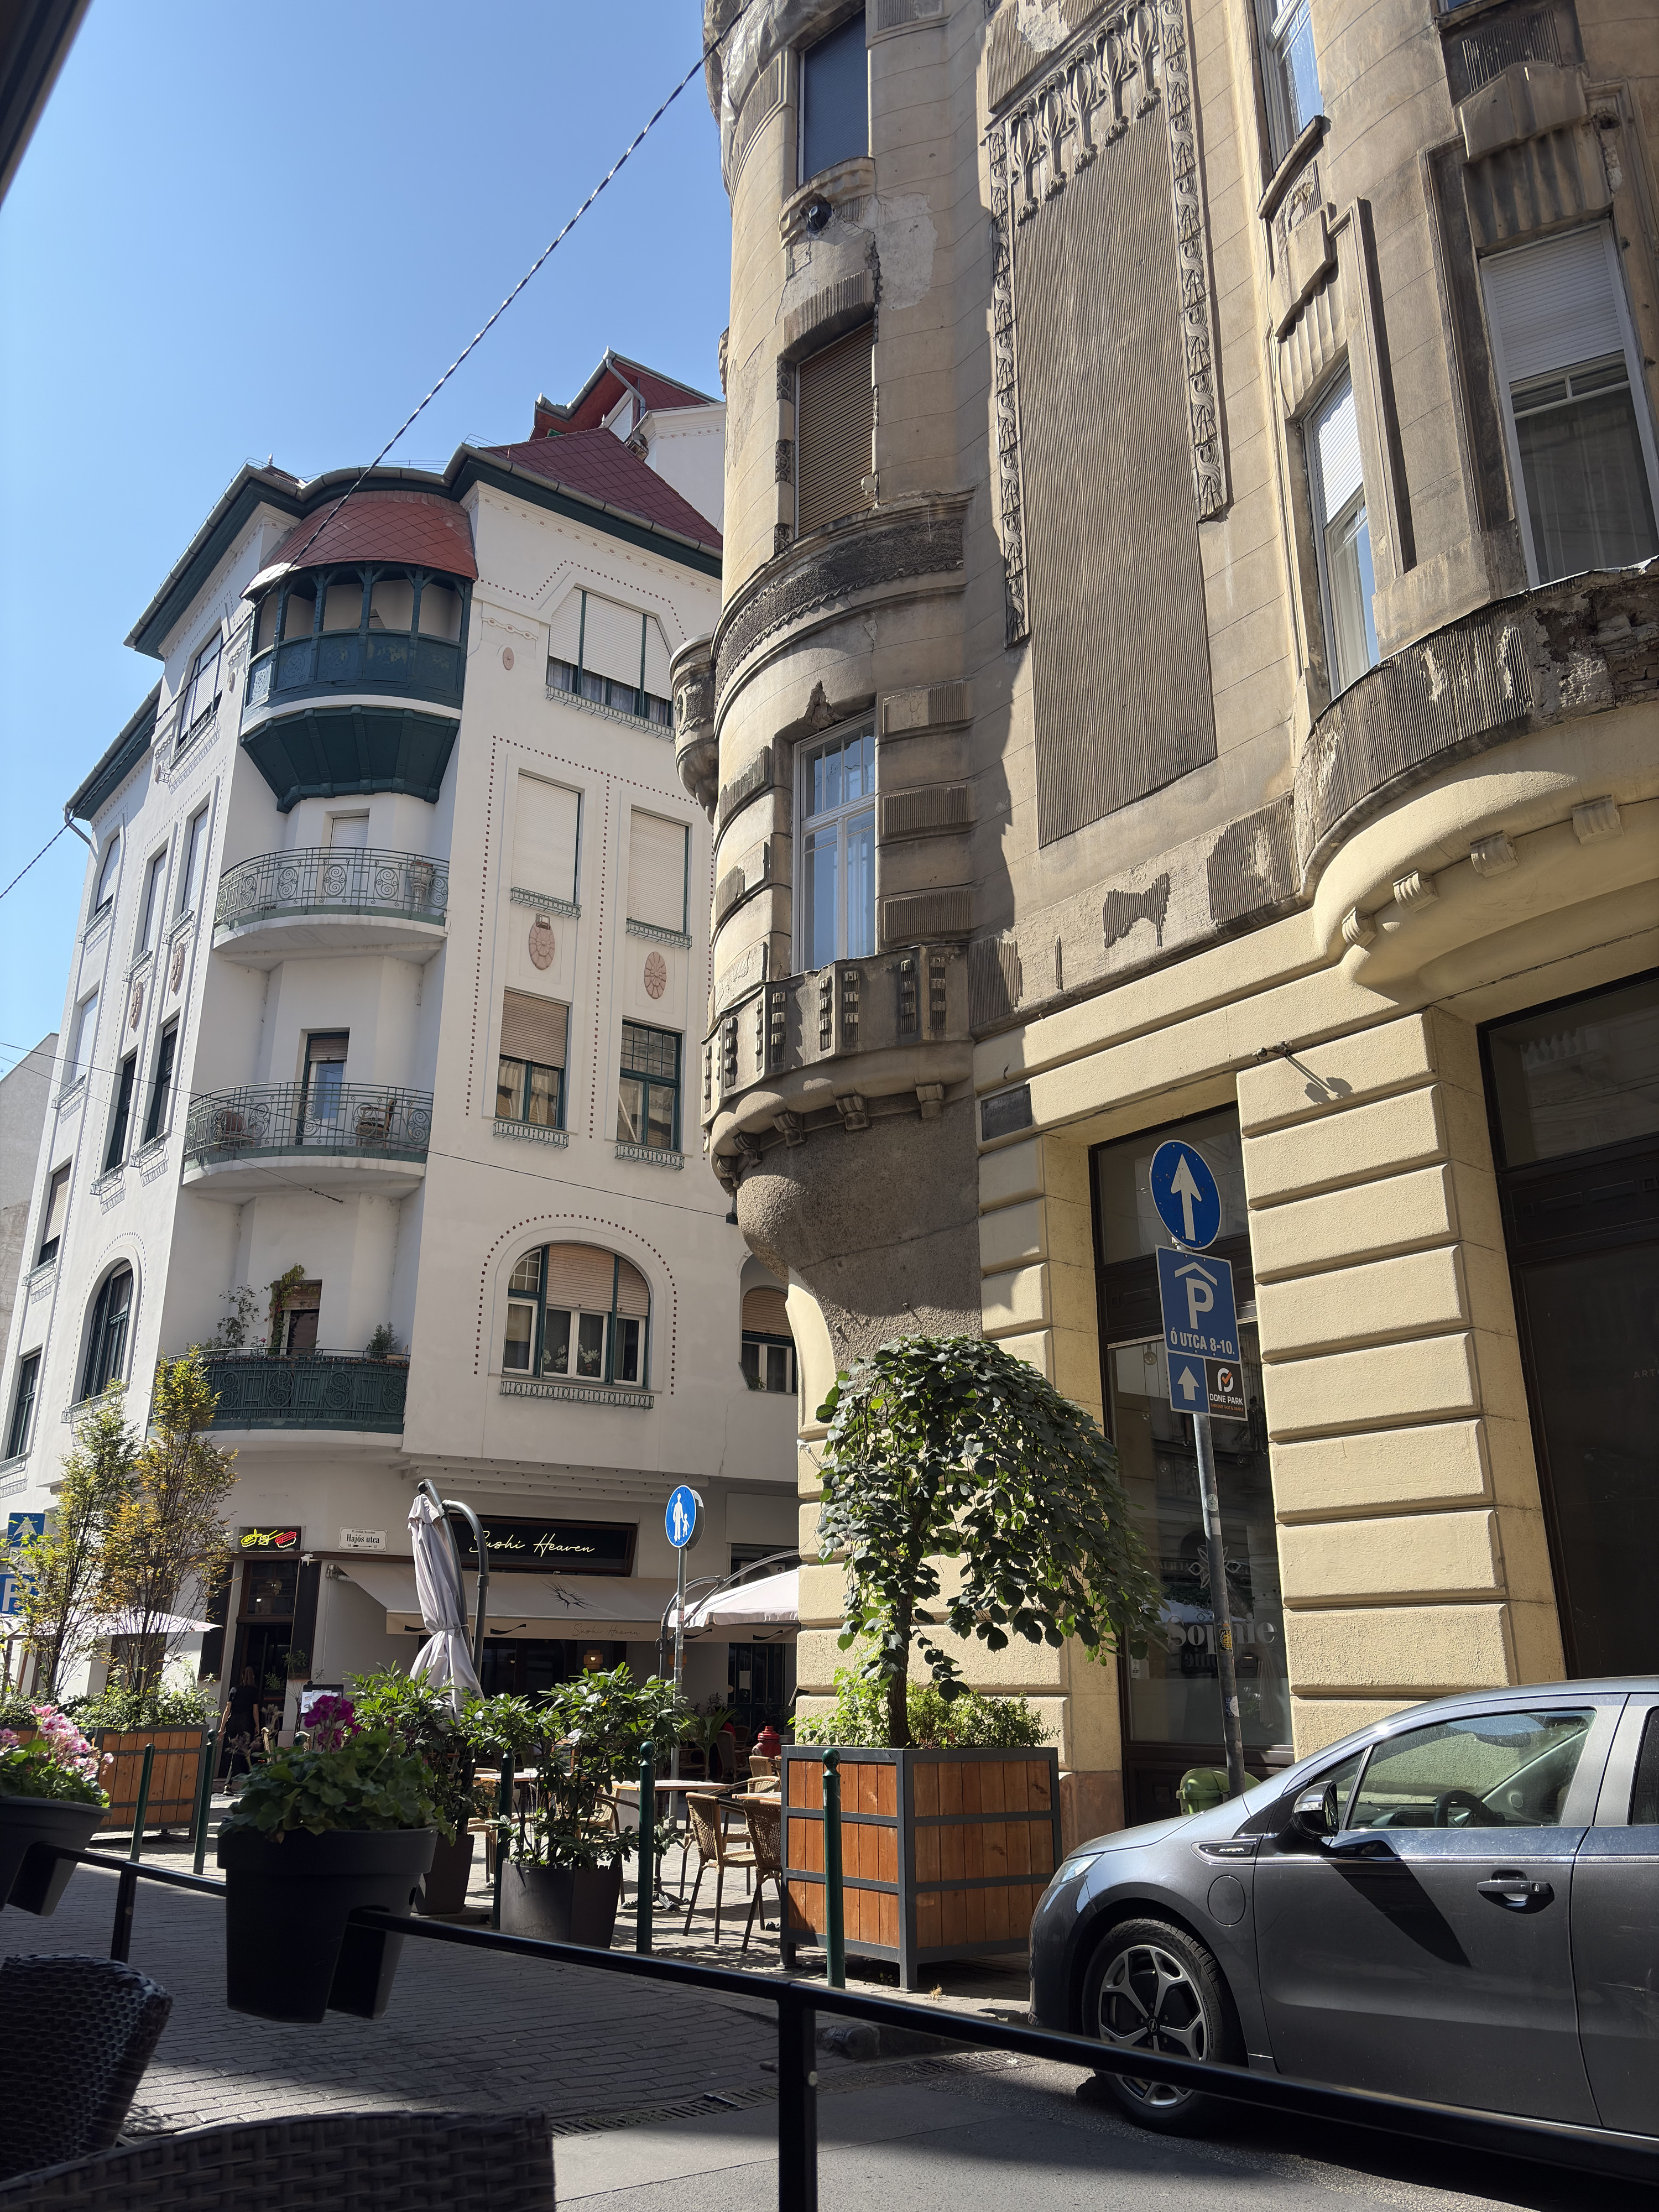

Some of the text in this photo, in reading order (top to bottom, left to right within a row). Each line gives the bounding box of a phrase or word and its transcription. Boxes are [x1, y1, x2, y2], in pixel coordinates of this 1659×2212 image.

[1186, 1277, 1214, 1329] P
[1171, 1327, 1235, 1355] Ó UTCA 8-10.
[1634, 1369, 1659, 1379] ART
[1209, 1393, 1244, 1406] DONE PARK
[346, 1533, 364, 1543] Hajós
[469, 1530, 595, 1557] Sushi Heaven
[572, 1623, 641, 1638] Sushi Heaven
